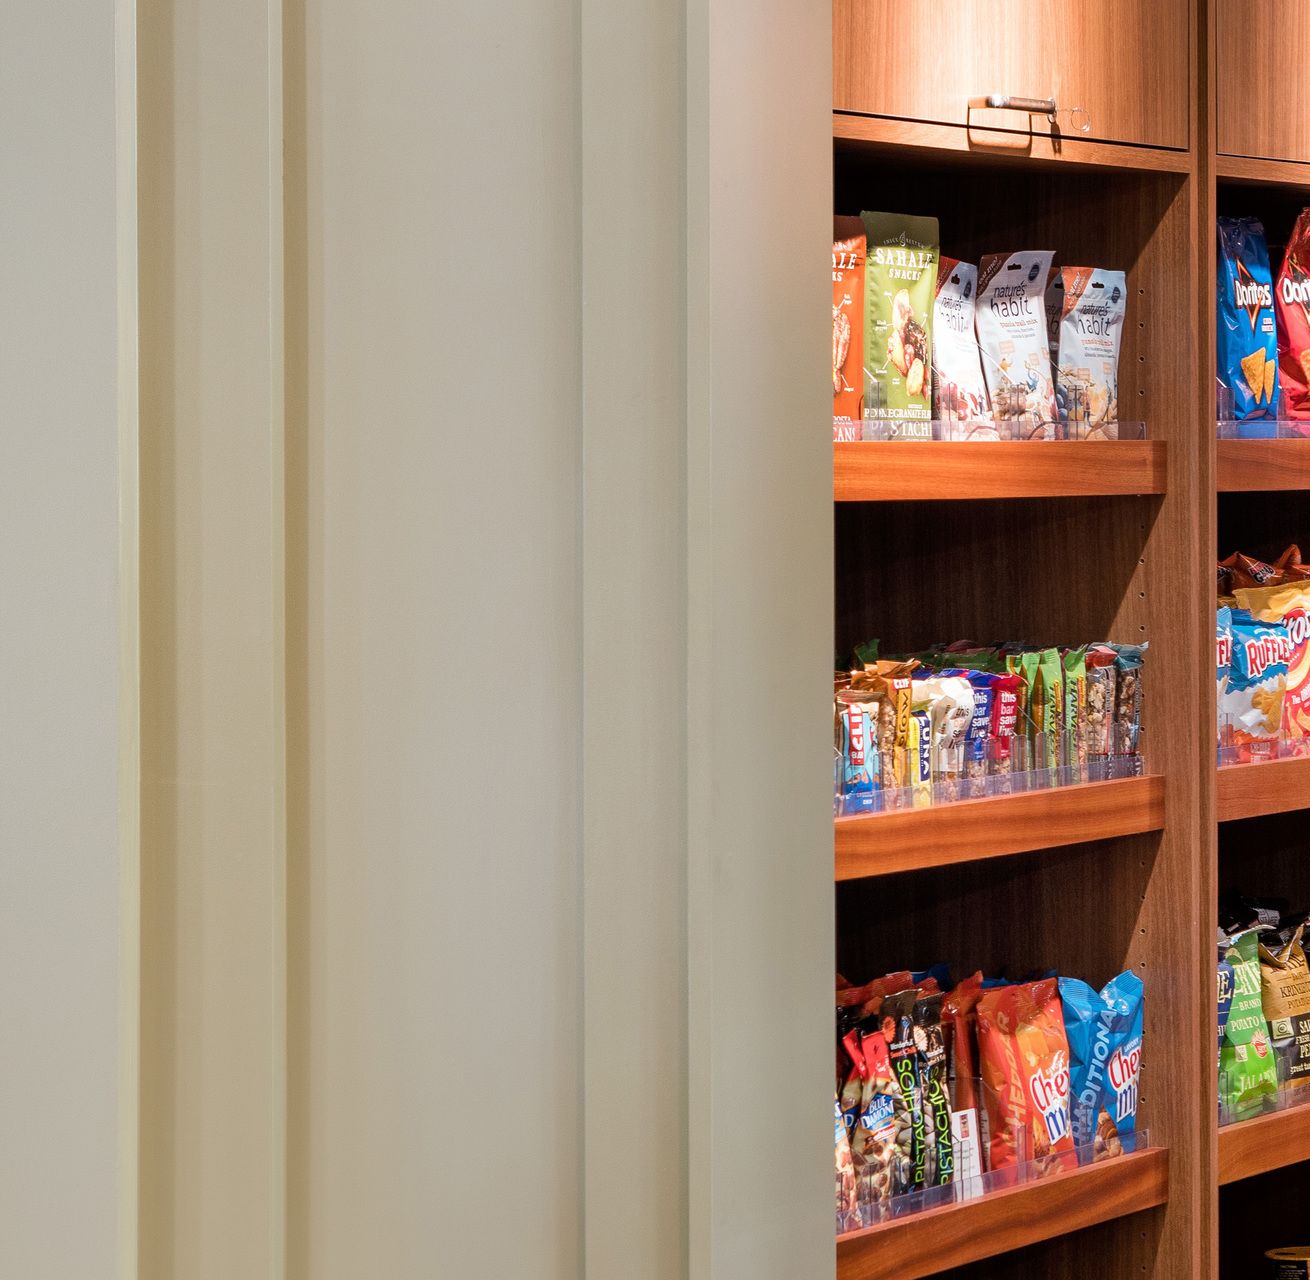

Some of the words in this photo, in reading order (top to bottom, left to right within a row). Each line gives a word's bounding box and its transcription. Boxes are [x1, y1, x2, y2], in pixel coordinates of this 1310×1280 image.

[875, 248, 932, 269] SAHALE
[889, 269, 922, 281] SNACKS
[993, 281, 1028, 298] nature's
[1234, 280, 1272, 307] Doritos
[989, 297, 1033, 318] habit
[1079, 301, 1111, 317] nature's
[1246, 637, 1291, 677] RUFFLE
[1001, 692, 1017, 703] this
[1001, 705, 1015, 715] bar
[850, 705, 863, 751] CLIF
[869, 1095, 889, 1115] BLUE
[1117, 1082, 1138, 1120] mi
[897, 1059, 926, 1183] PISTACHIOS
